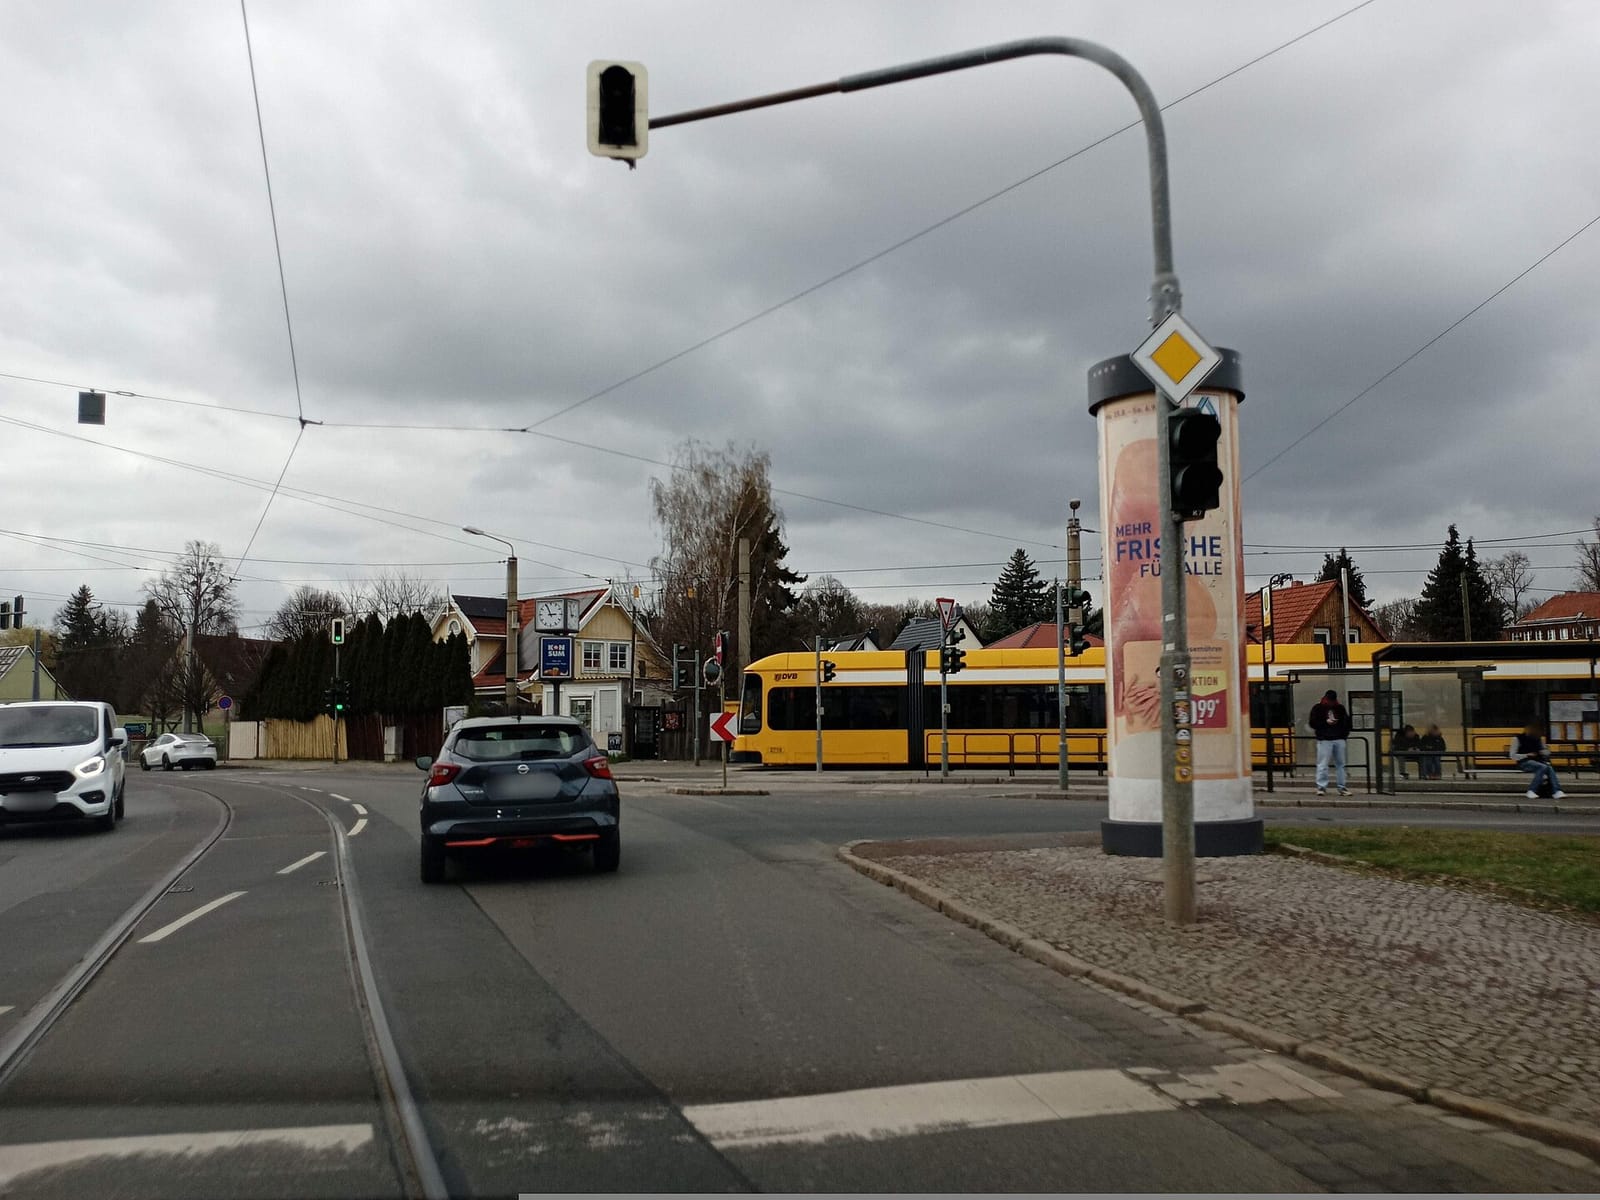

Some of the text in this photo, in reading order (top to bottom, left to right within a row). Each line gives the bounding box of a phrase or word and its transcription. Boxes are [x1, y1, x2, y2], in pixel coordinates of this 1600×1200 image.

[1116, 522, 1151, 537] MEHR
[1140, 560, 1222, 577] FÜ ALLE
[1191, 676, 1218, 686] KTION
